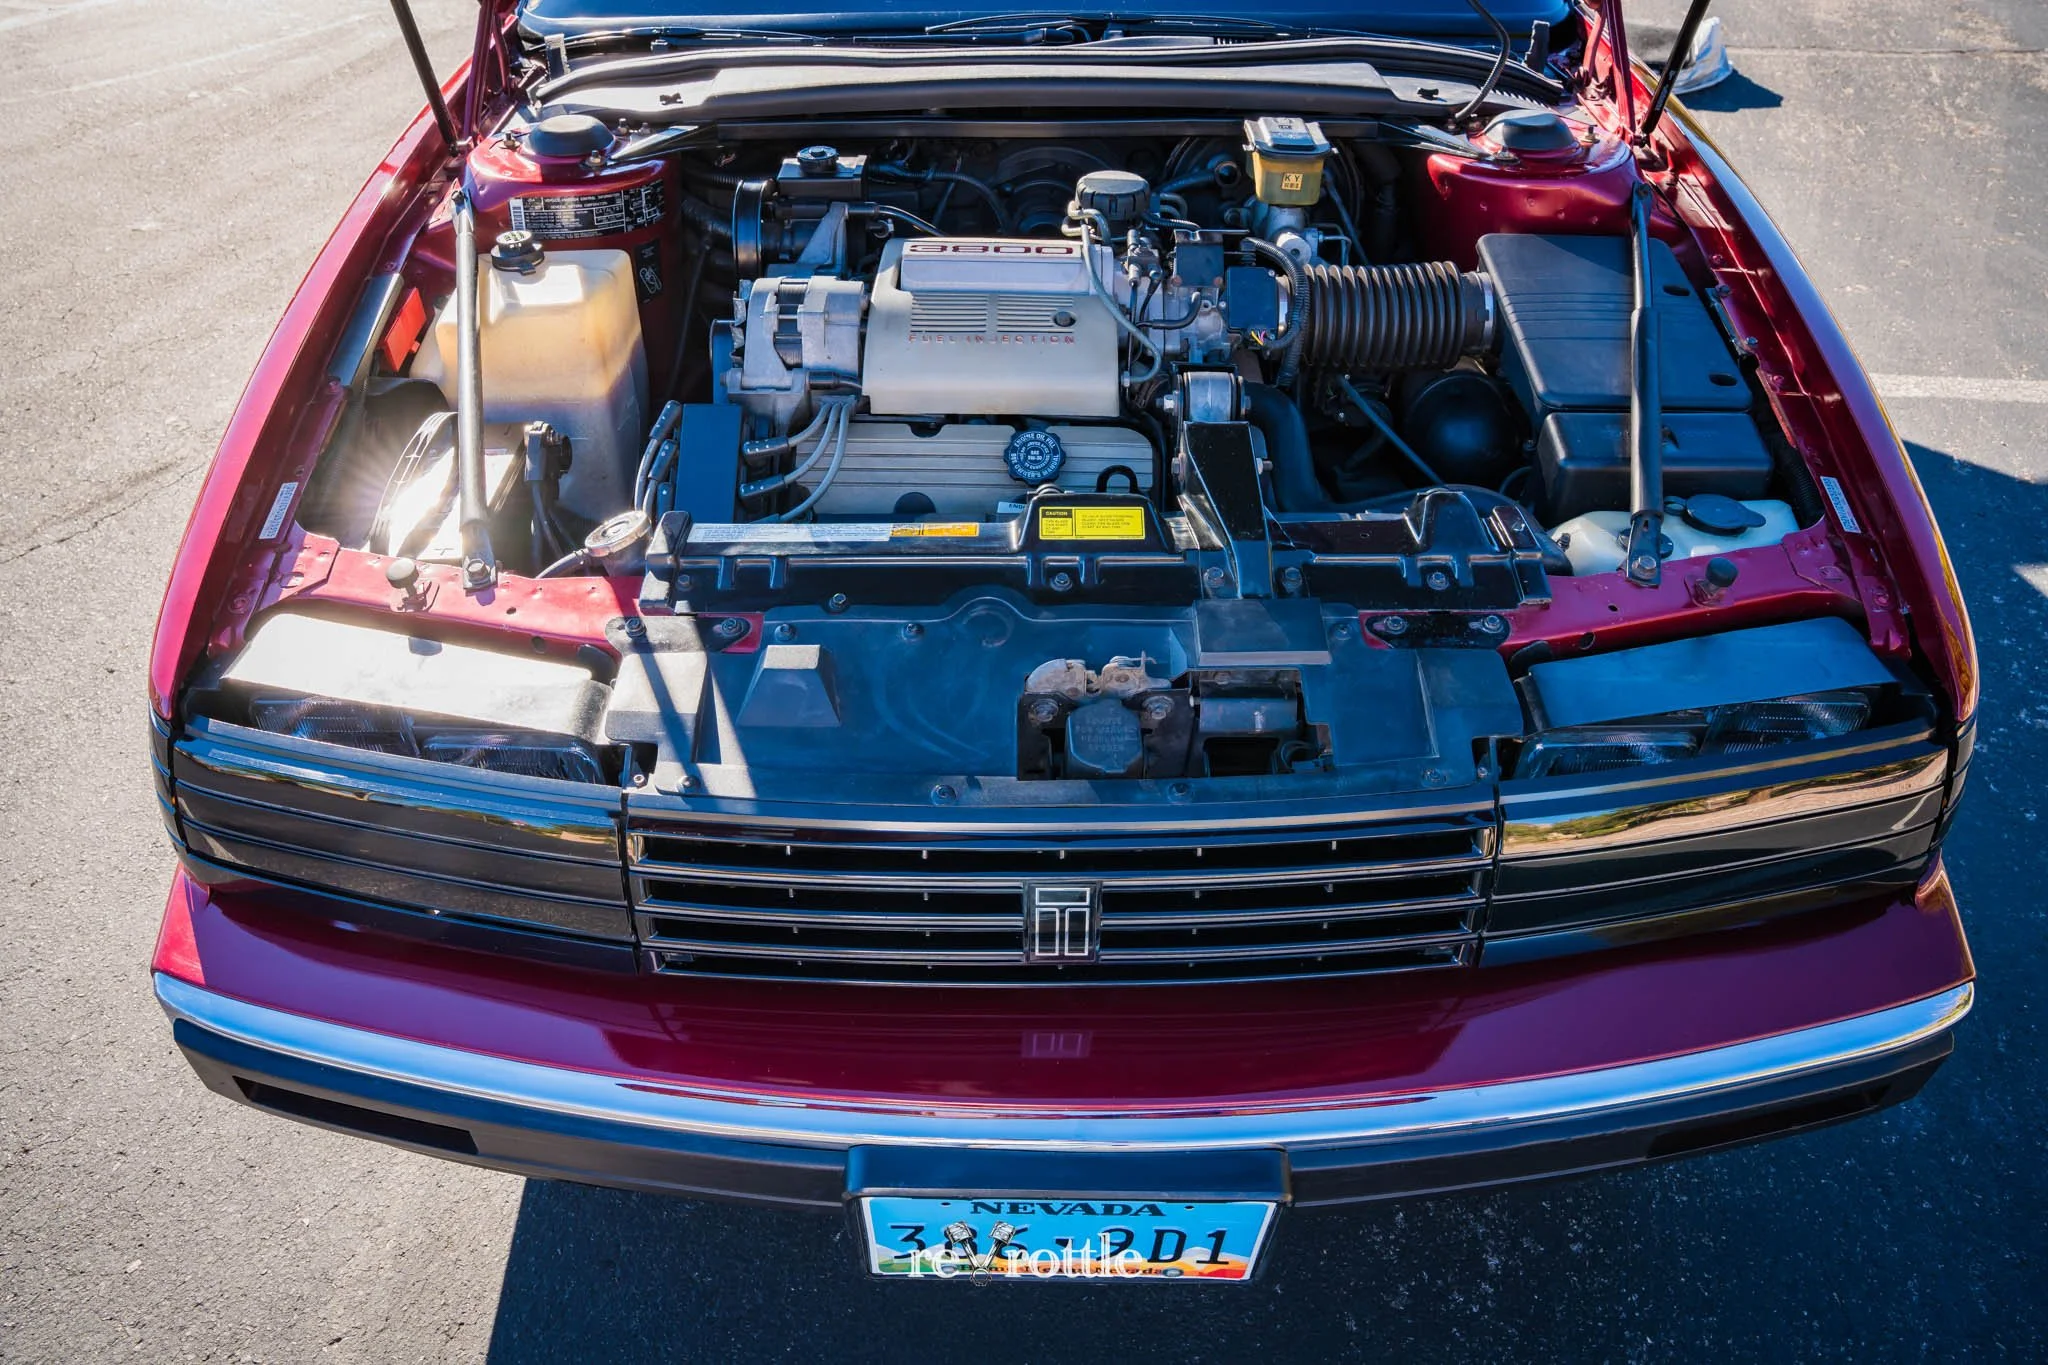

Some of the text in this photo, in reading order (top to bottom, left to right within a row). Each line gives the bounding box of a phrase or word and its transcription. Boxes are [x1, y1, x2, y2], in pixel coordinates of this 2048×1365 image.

[908, 334, 1075, 345] FUEL INJECTION
[1036, 433, 1046, 441] OIL
[969, 1201, 1167, 1217] NEVADA
